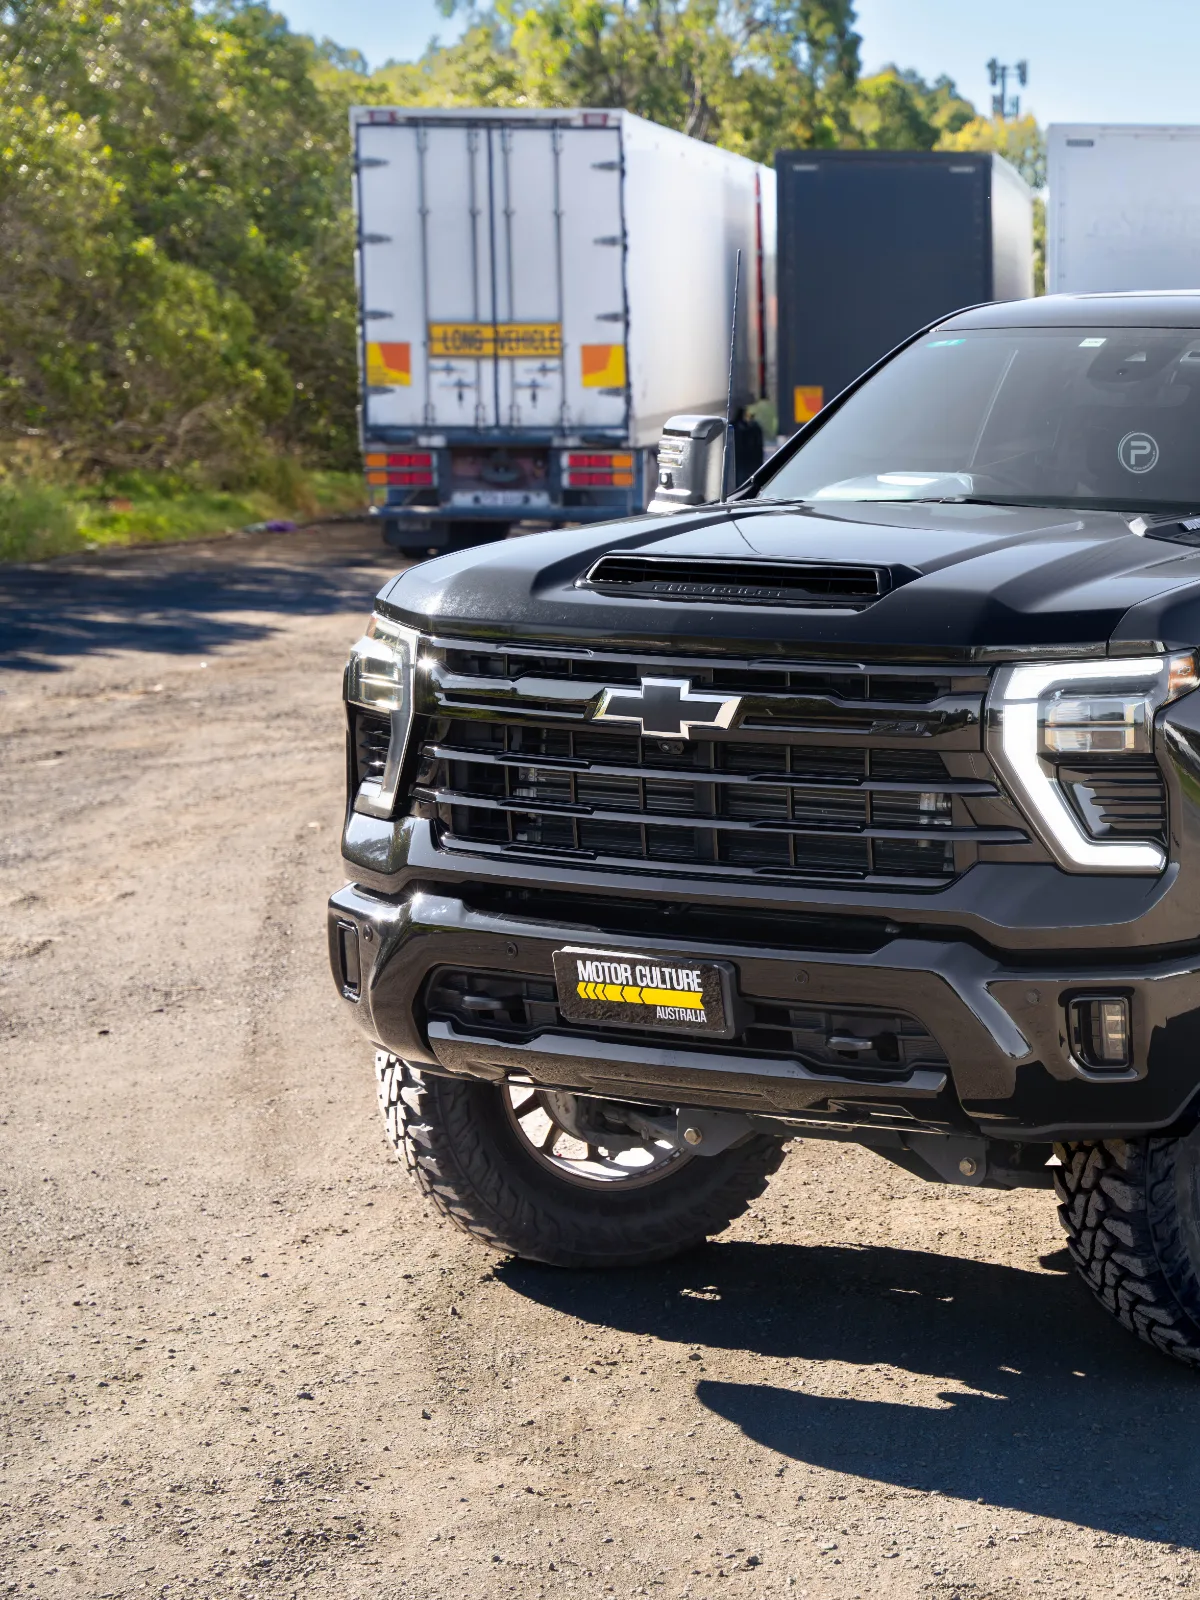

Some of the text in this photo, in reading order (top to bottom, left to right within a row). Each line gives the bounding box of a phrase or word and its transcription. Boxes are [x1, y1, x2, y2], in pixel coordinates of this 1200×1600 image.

[442, 328, 559, 351] LONG VEHICLE
[651, 583, 788, 598] CHEVROLET
[576, 959, 703, 992] MOTOR CULTURE
[656, 1005, 707, 1023] AUSTRALIA
